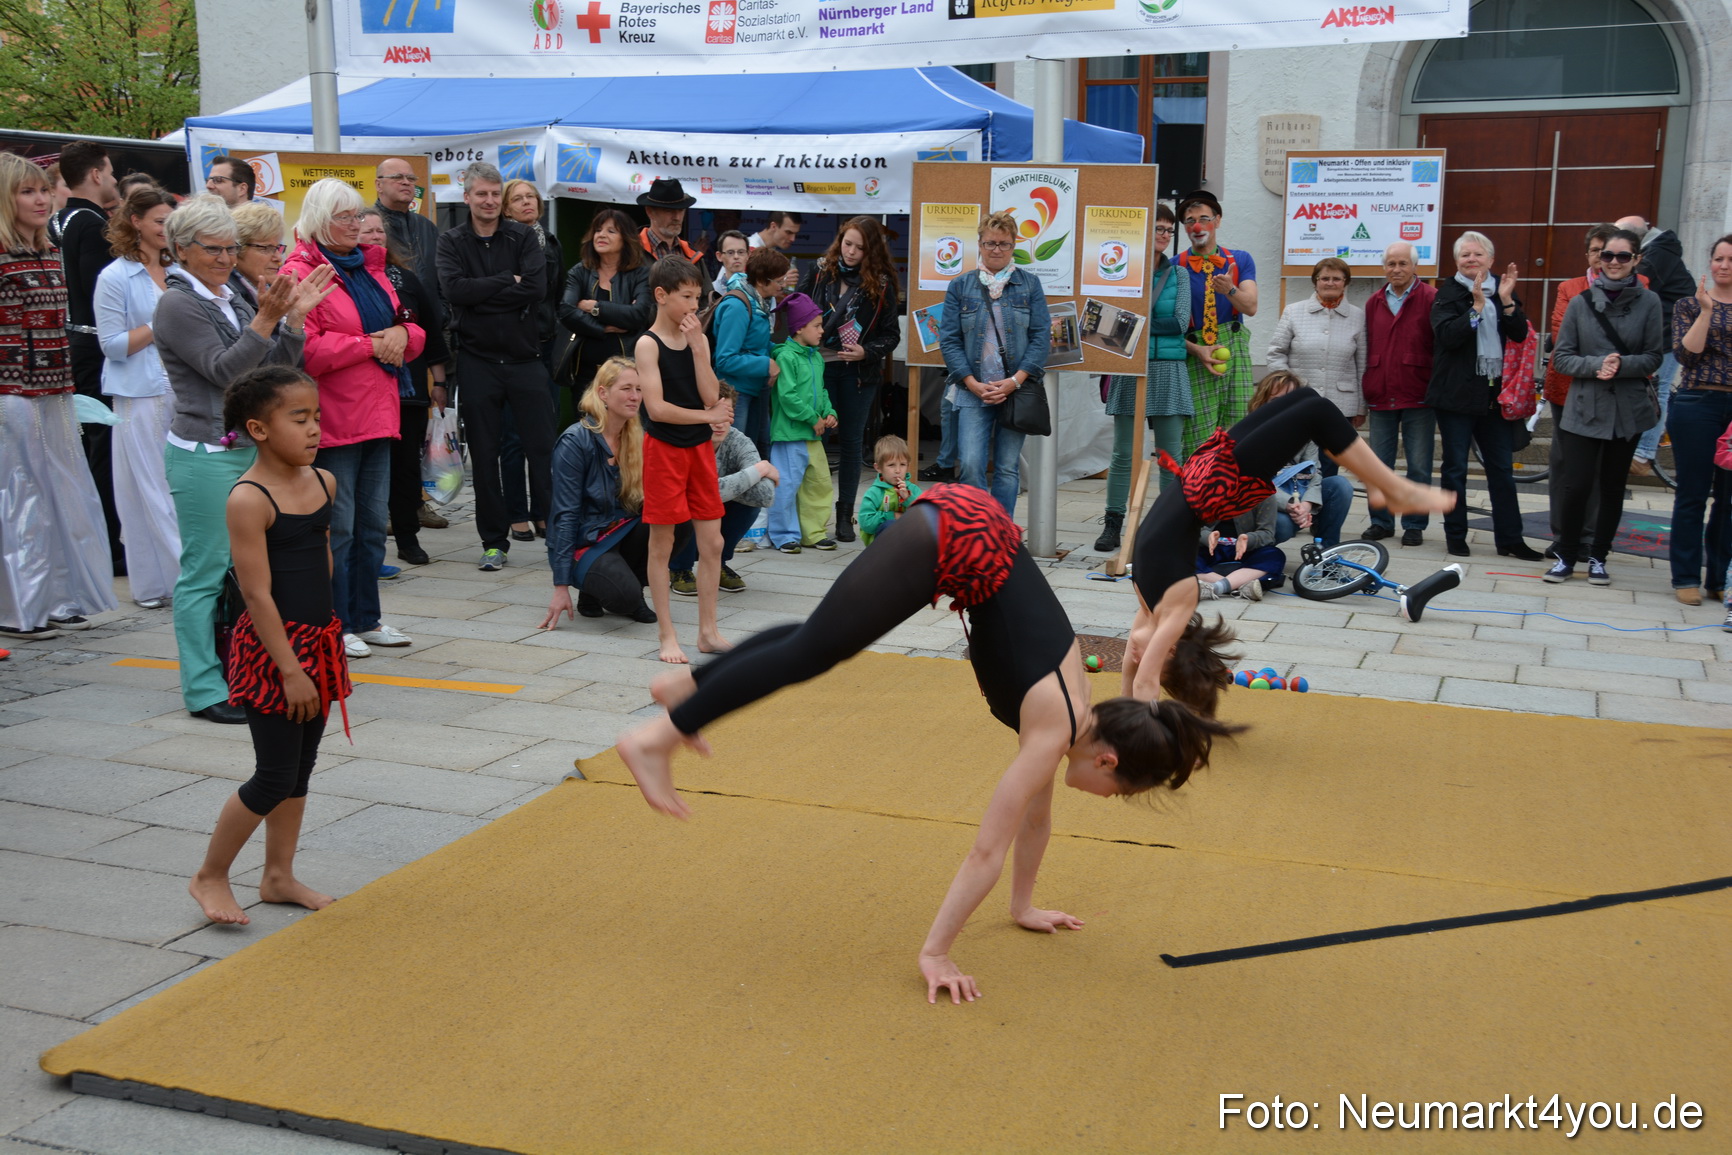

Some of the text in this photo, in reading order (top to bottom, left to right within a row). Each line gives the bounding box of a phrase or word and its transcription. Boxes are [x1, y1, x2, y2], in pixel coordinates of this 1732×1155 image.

[620, 2, 701, 15] Bayerisches
[818, 0, 934, 22] Nürnberger Land
[619, 15, 657, 28] Rotes
[737, 11, 801, 28] Sozialstation
[736, 26, 809, 43] Neumarkt e.V.
[819, 22, 885, 39] Neumarkt
[619, 31, 656, 44] Kreuz
[706, 33, 733, 44] caritas
[626, 150, 888, 169] Aktionen zur Inklusion
[1318, 159, 1350, 167] Neumarkt
[1354, 159, 1372, 167] Offen
[1373, 159, 1385, 167] und
[1386, 158, 1411, 167] inklusiv
[302, 168, 356, 178] WETTBEWERB
[806, 184, 852, 193] Regens Wagner
[998, 173, 1072, 194] SYMPATHIEBLUME
[926, 205, 976, 215] URKUNDE
[1091, 208, 1143, 219] URKUNDE
[1370, 203, 1425, 212] NEUMARKT
